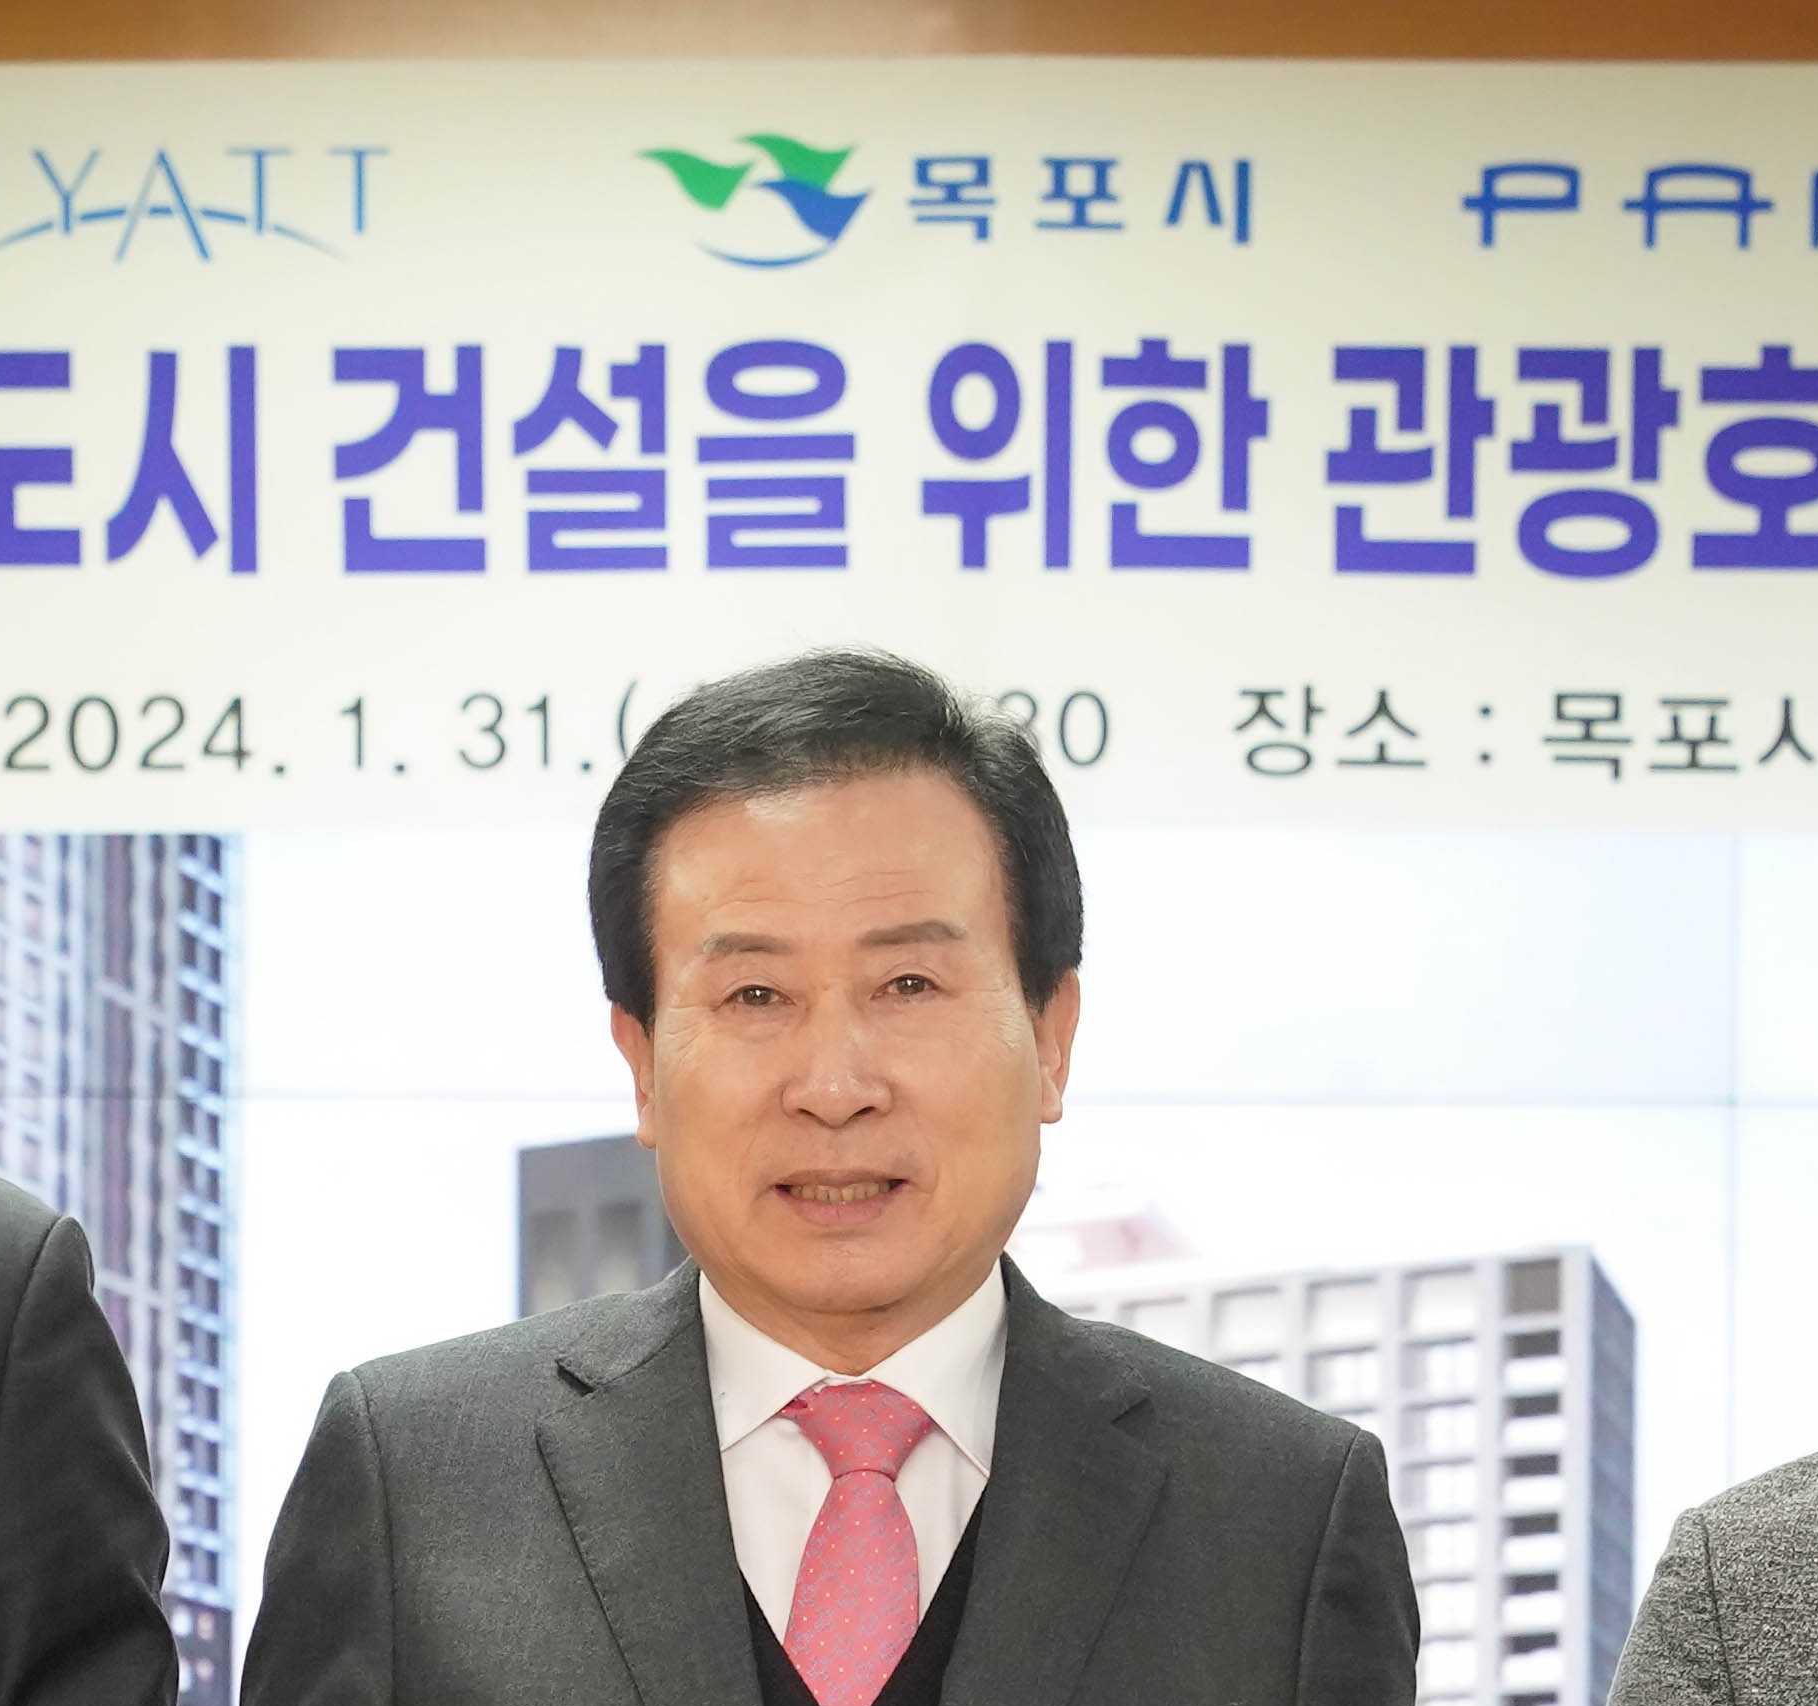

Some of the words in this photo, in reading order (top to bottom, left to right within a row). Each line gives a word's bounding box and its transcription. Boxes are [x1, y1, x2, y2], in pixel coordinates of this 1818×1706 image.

[909, 154, 1254, 246] 목포시
[331, 338, 856, 574] 건설을
[920, 336, 1271, 572] 위한
[3, 694, 285, 775] 2024.
[1233, 684, 1428, 778] 장소
